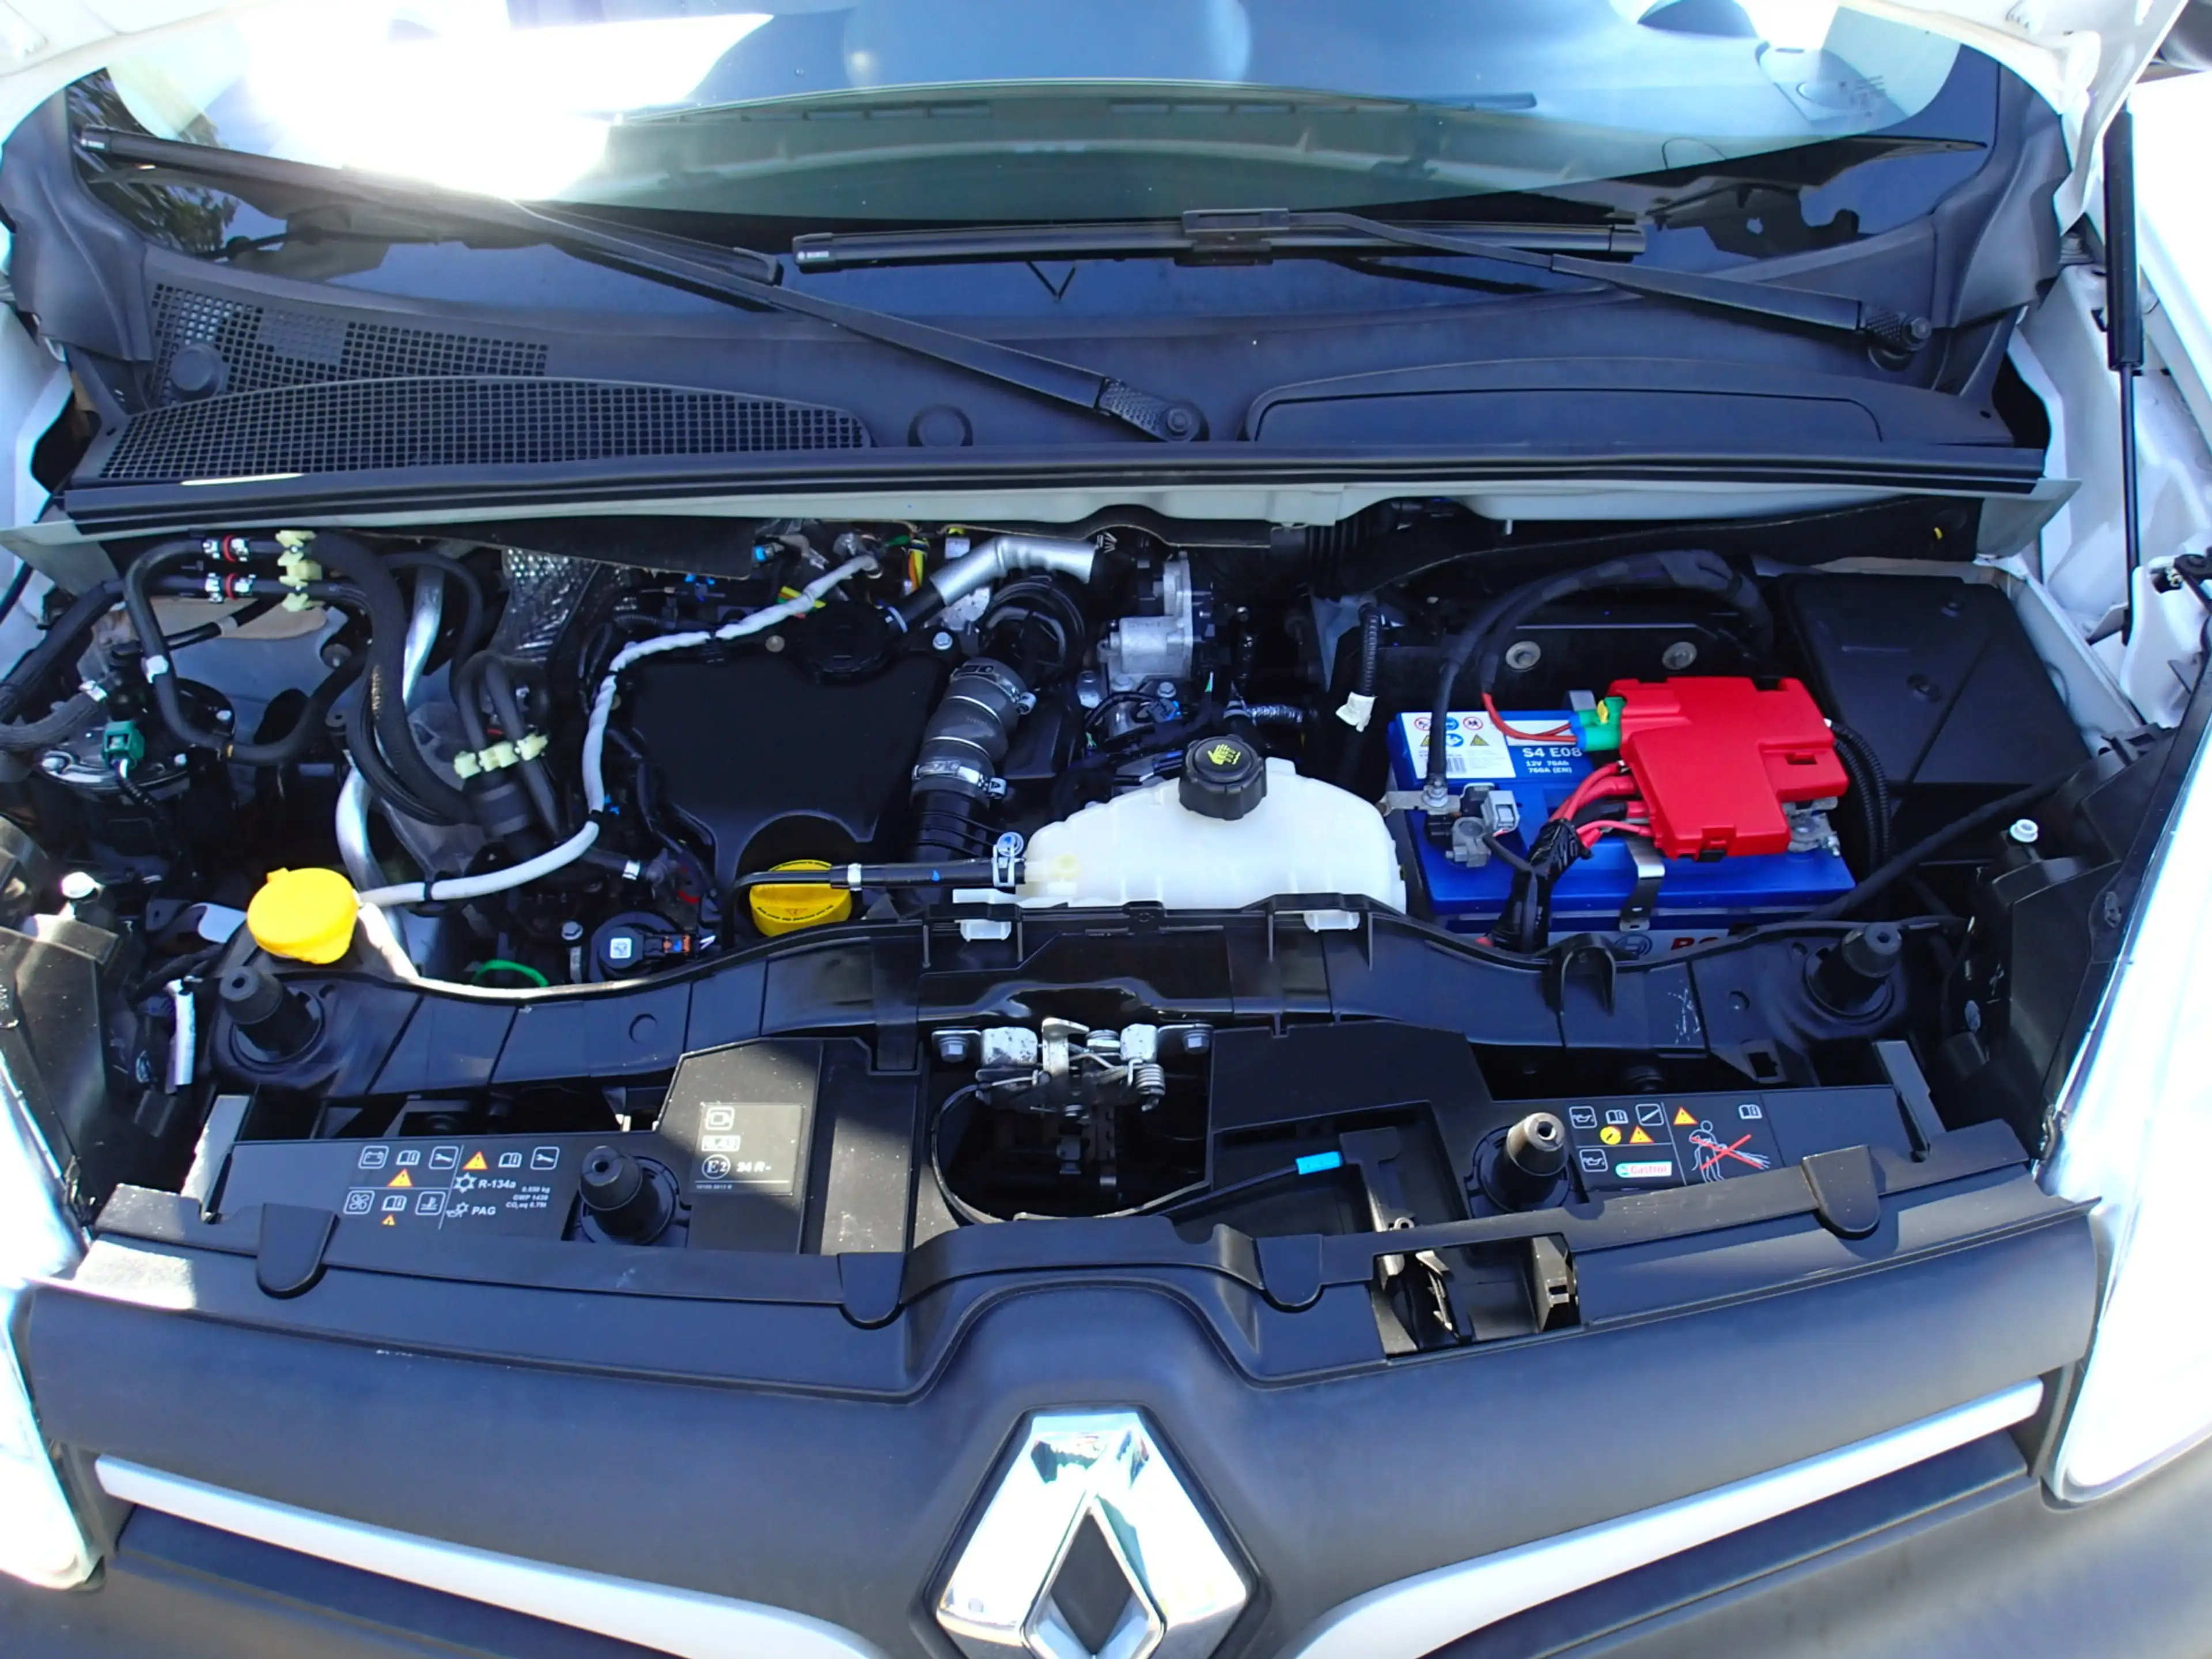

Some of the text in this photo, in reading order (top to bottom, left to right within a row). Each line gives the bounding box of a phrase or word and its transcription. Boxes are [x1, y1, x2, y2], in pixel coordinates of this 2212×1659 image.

[1522, 747, 1582, 757] S4 E08
[478, 1179, 516, 1188] R-134a
[471, 1206, 496, 1215] PAG
